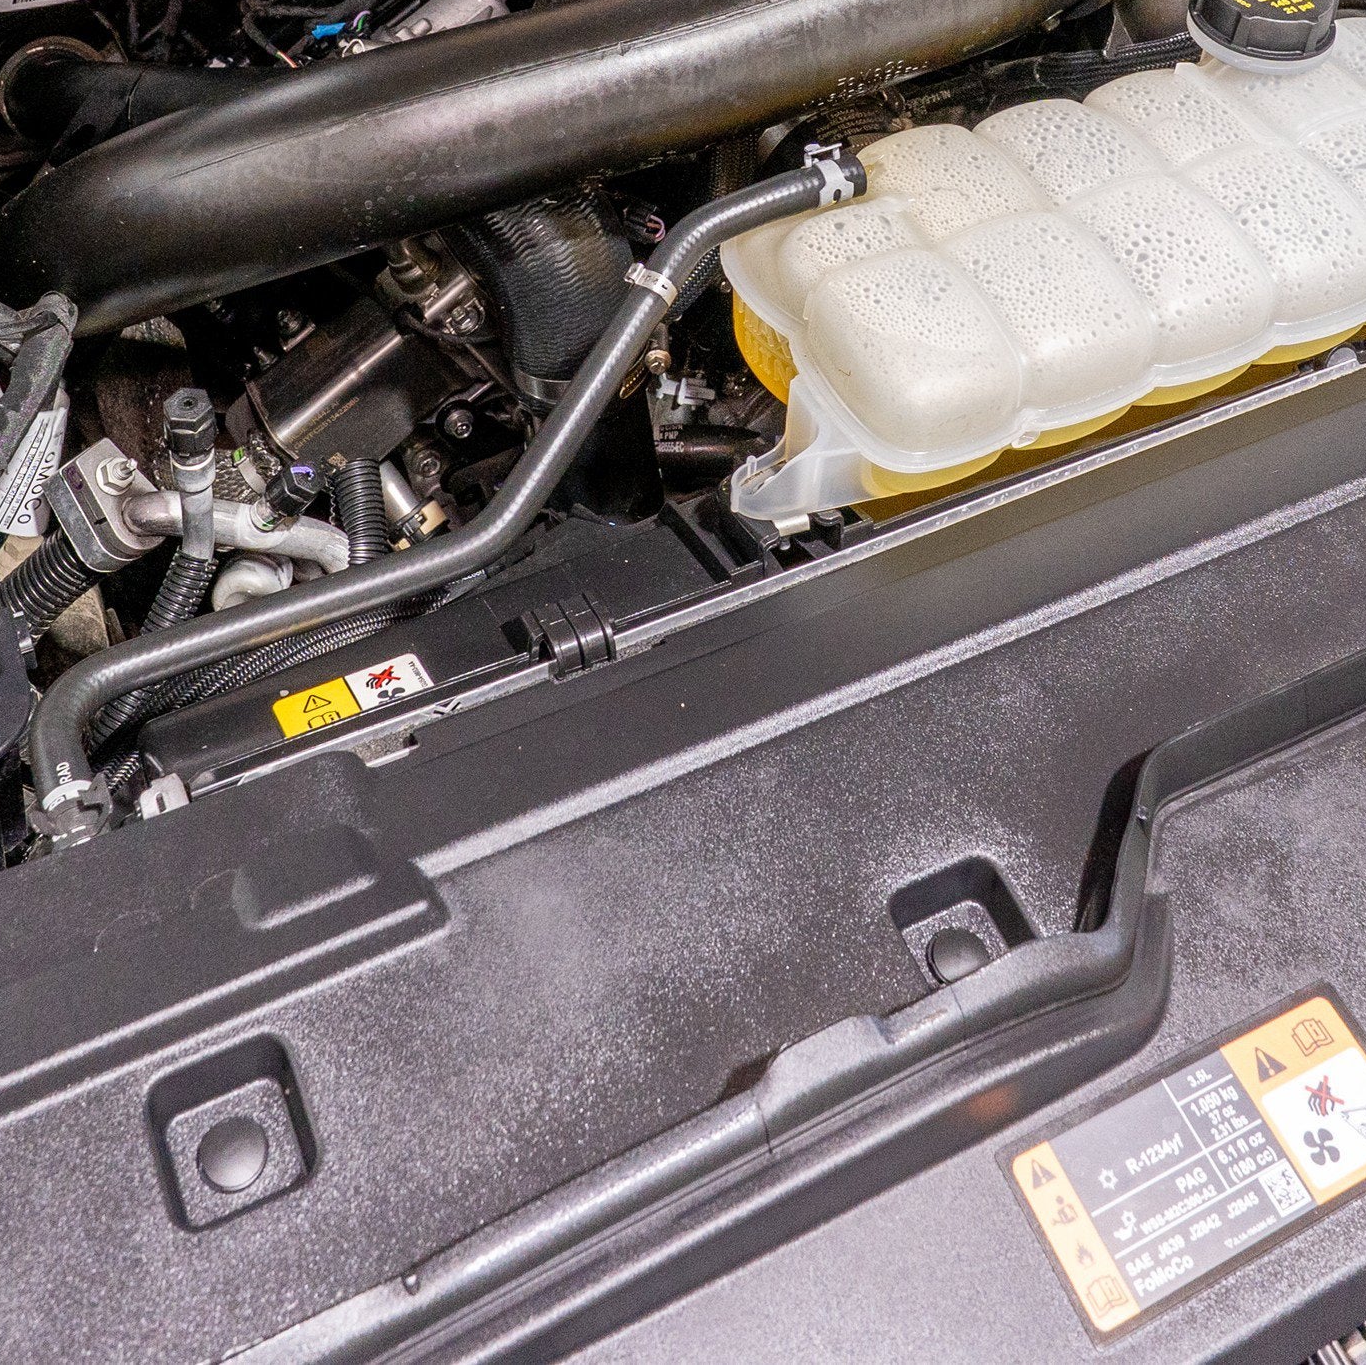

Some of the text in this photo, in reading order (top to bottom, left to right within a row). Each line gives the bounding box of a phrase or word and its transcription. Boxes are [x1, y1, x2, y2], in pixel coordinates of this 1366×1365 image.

[17, 435, 59, 524] oMoCo
[56, 761, 73, 785] RAD
[1190, 1085, 1238, 1115] 1.050 kg
[1208, 1104, 1235, 1124] 37 oz
[1210, 1115, 1248, 1140] 2.31 lbs
[1125, 1133, 1182, 1173] R-1234yf
[1217, 1132, 1265, 1164] 6.1 fl oz
[1256, 1145, 1277, 1165] cc)
[1175, 1167, 1206, 1192] PAG
[1125, 1252, 1153, 1276] SAE
[1134, 1255, 1192, 1295] FoMoCo
